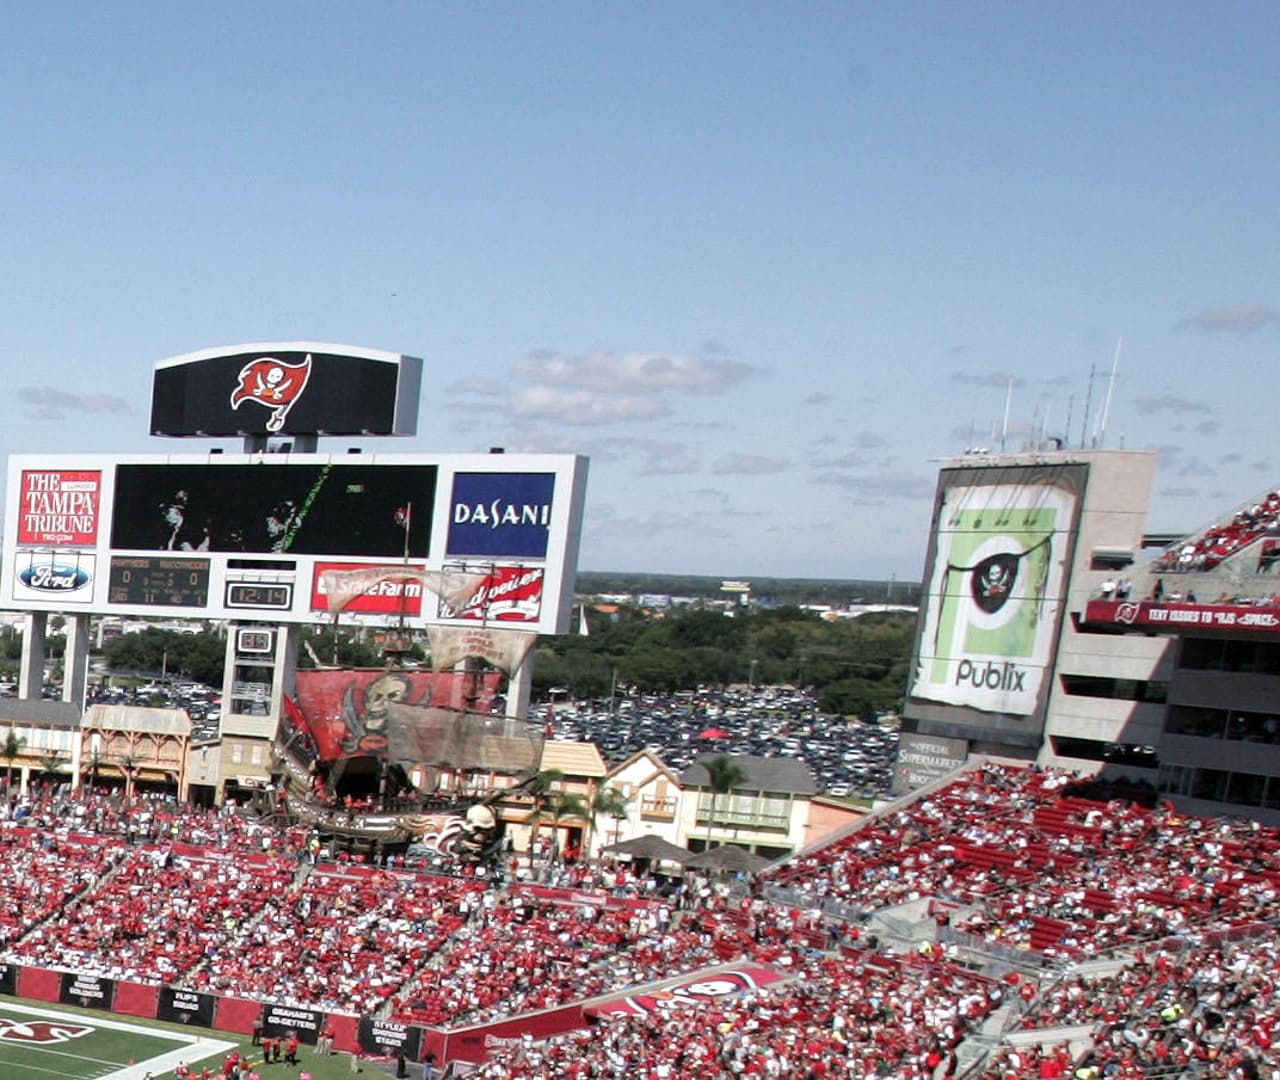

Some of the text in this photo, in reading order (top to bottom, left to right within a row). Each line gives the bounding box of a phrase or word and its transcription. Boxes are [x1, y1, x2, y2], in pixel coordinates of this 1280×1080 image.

[27, 473, 60, 491] THE
[26, 491, 94, 515] TAMPA
[454, 499, 551, 530] DASANI
[25, 514, 94, 534] TRIBUNE
[30, 564, 78, 588] Ford
[379, 578, 422, 598] Farm
[440, 568, 543, 619] dweiser
[956, 660, 1027, 693] Publix
